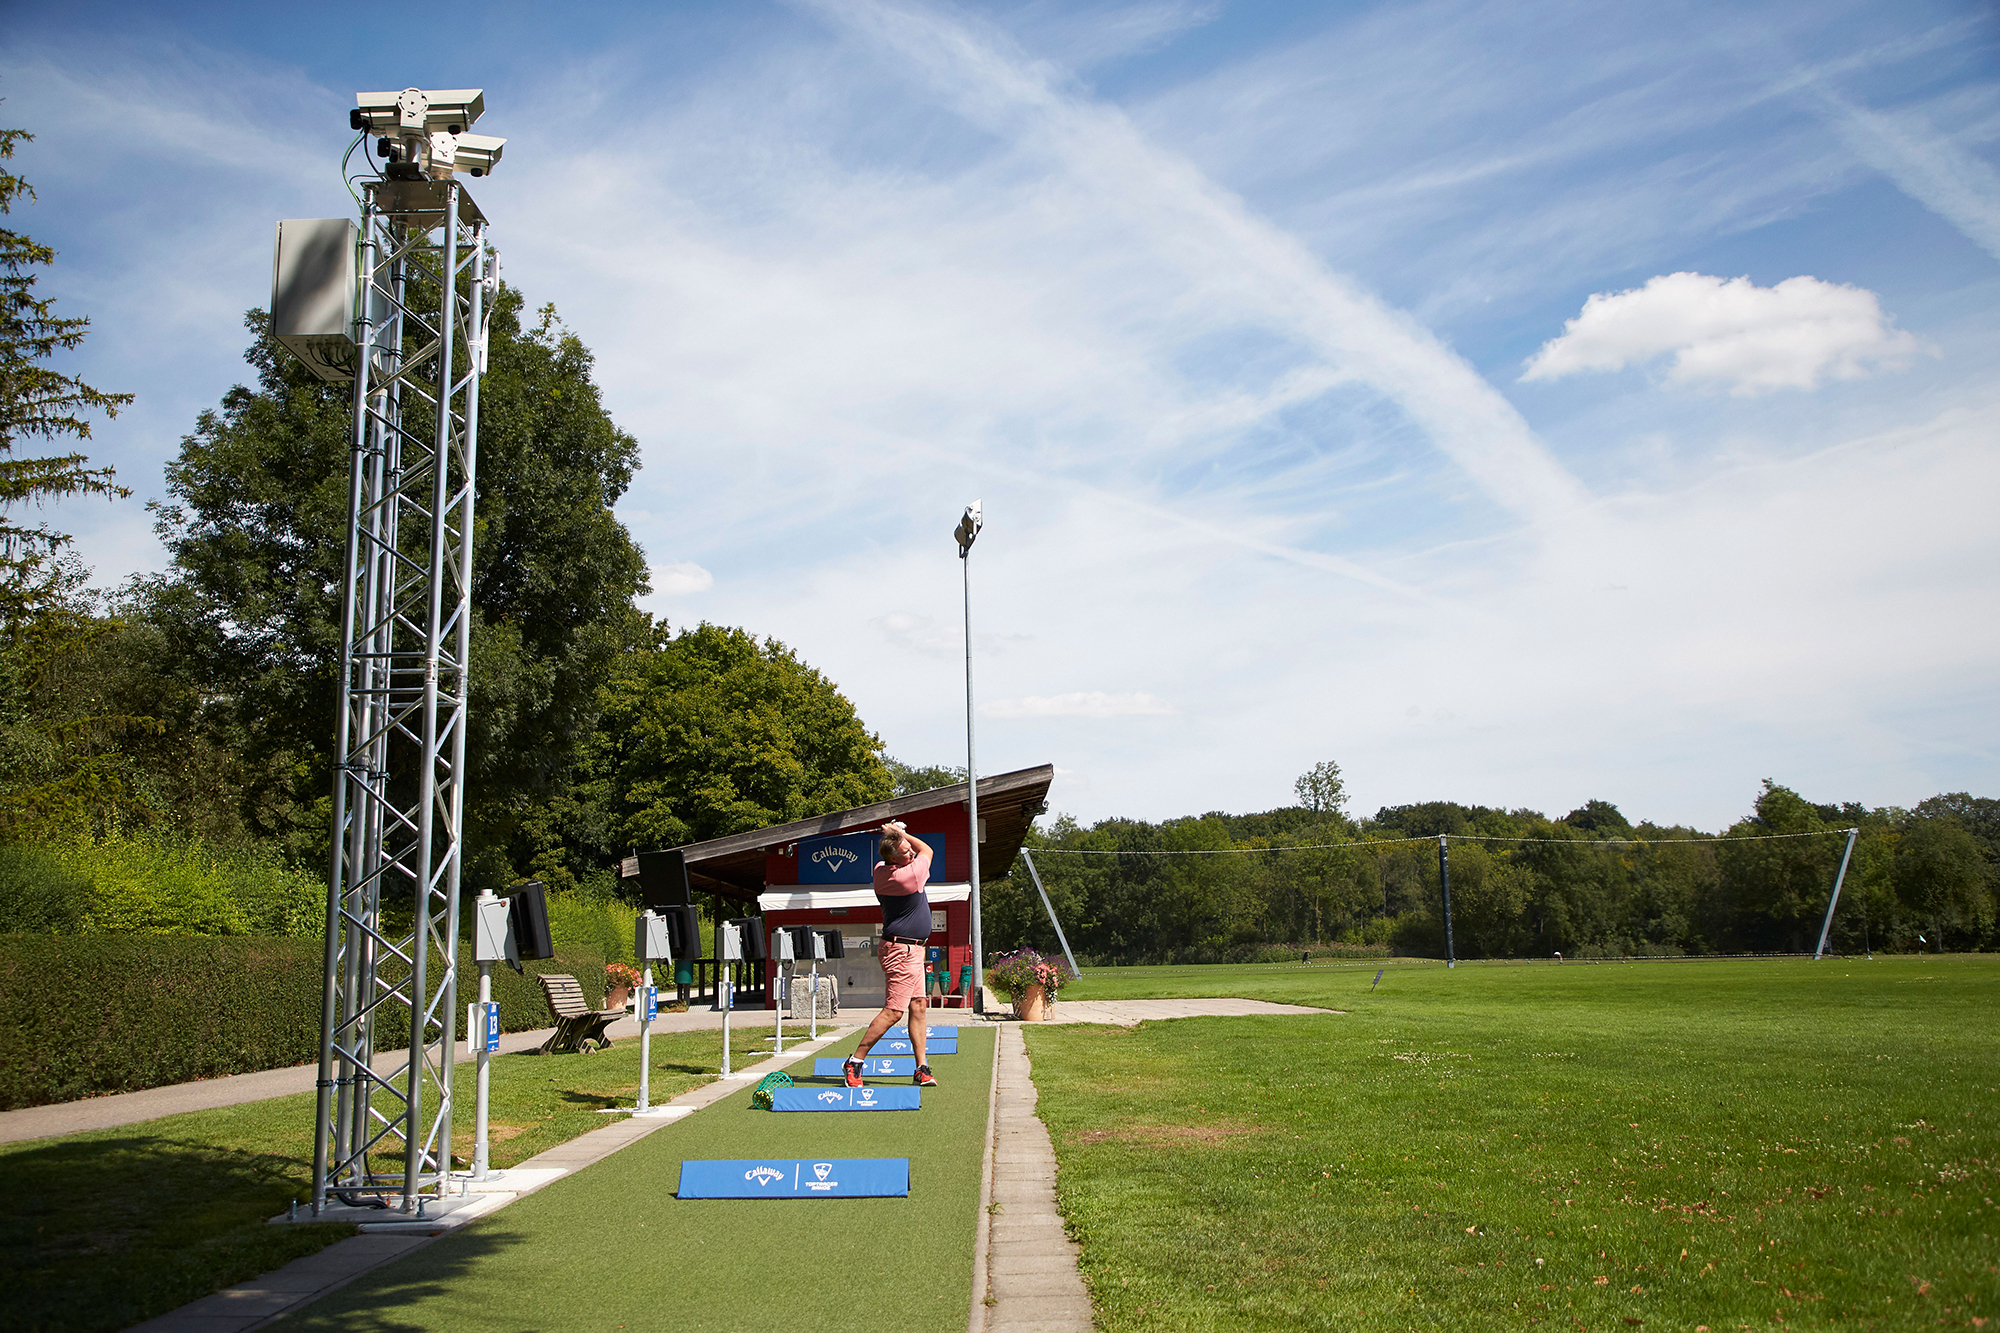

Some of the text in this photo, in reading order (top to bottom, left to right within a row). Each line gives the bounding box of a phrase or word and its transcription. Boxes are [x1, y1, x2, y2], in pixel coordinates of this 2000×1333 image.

[811, 845, 859, 863] Callaway
[489, 1015, 498, 1035] 13
[744, 1165, 785, 1181] Callaway
